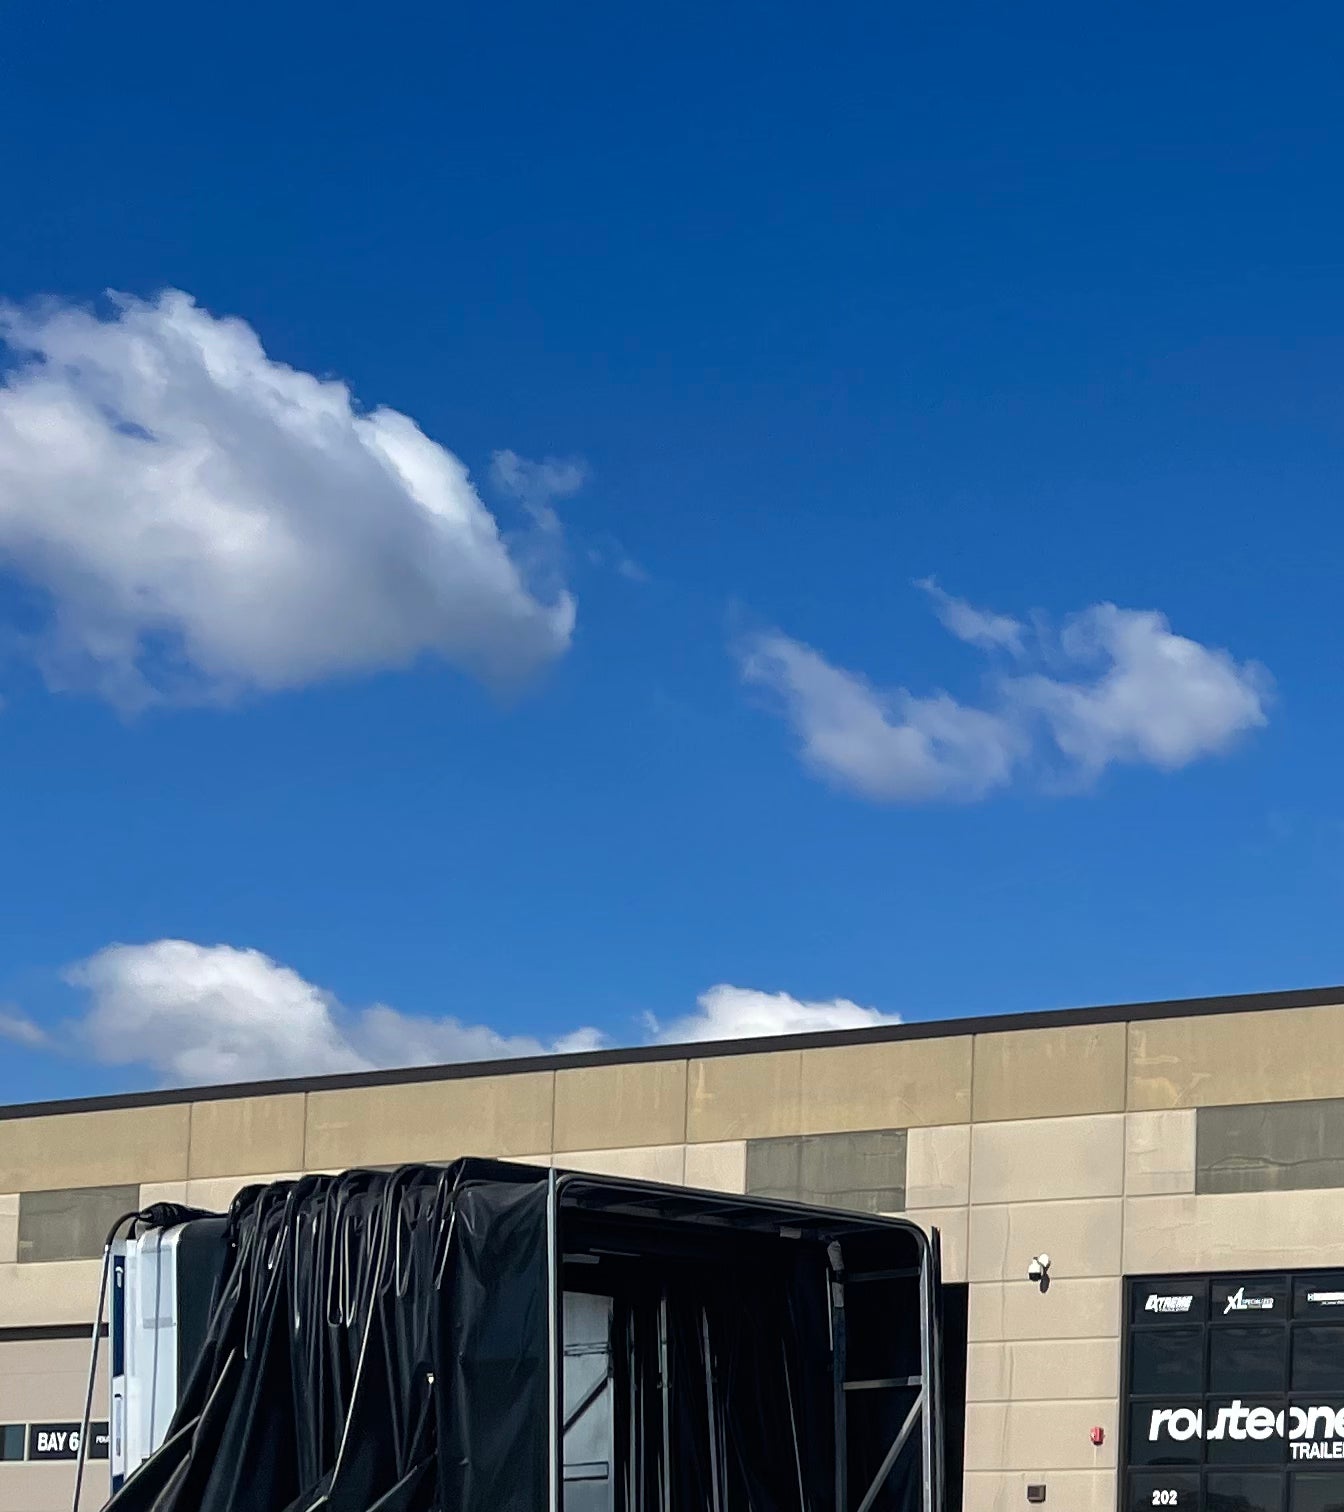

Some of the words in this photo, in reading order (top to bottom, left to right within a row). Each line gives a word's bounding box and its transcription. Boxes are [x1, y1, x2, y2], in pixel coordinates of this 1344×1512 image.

[38, 1432, 67, 1451] BAY
[69, 1432, 79, 1451] 6
[1152, 1490, 1178, 1505] 202
